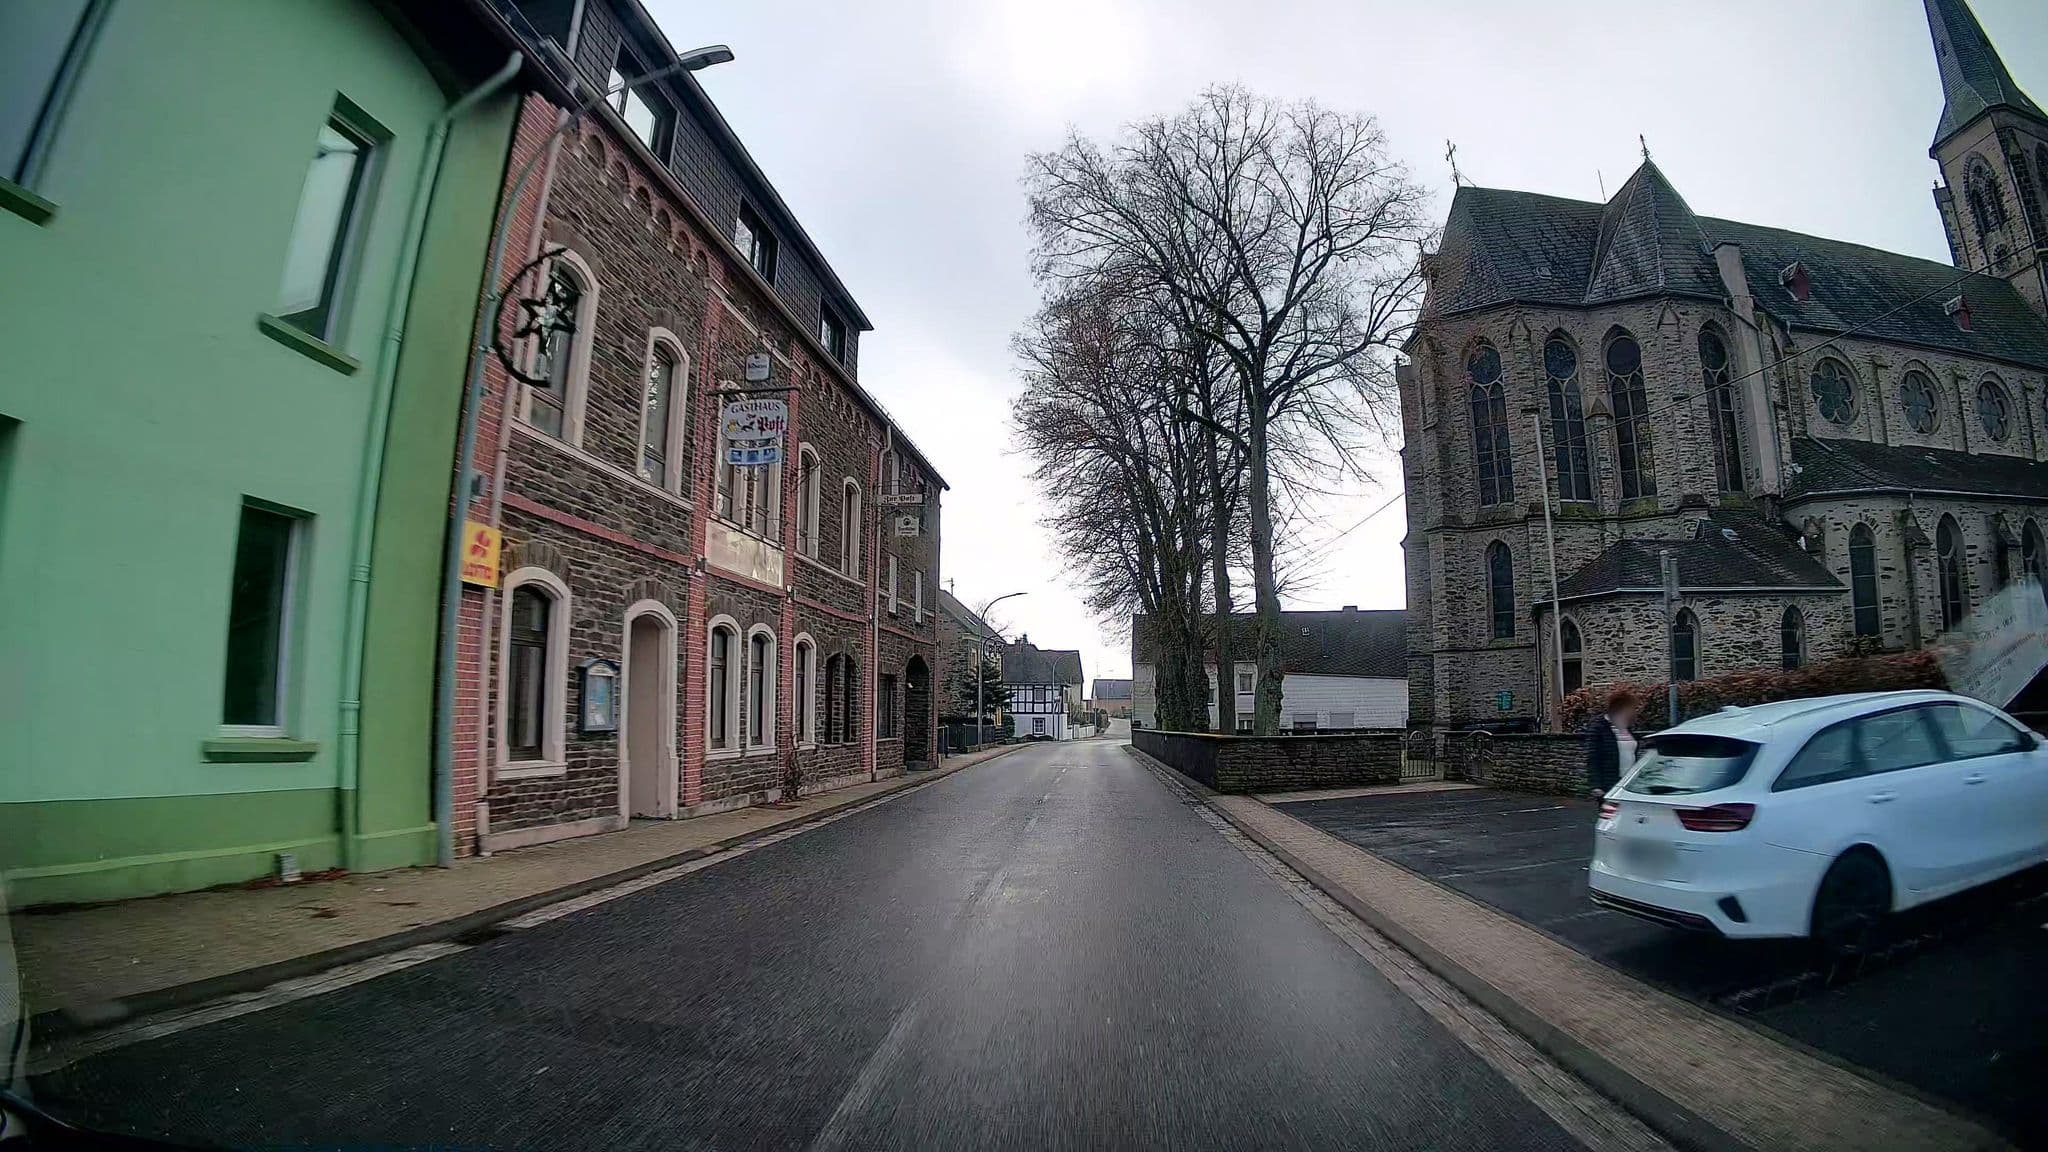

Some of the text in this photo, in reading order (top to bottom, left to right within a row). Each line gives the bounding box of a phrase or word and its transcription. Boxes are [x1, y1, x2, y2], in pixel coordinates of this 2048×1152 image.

[731, 402, 780, 414] GASTHAUS
[757, 416, 785, 436] Post
[898, 495, 915, 503] Post
